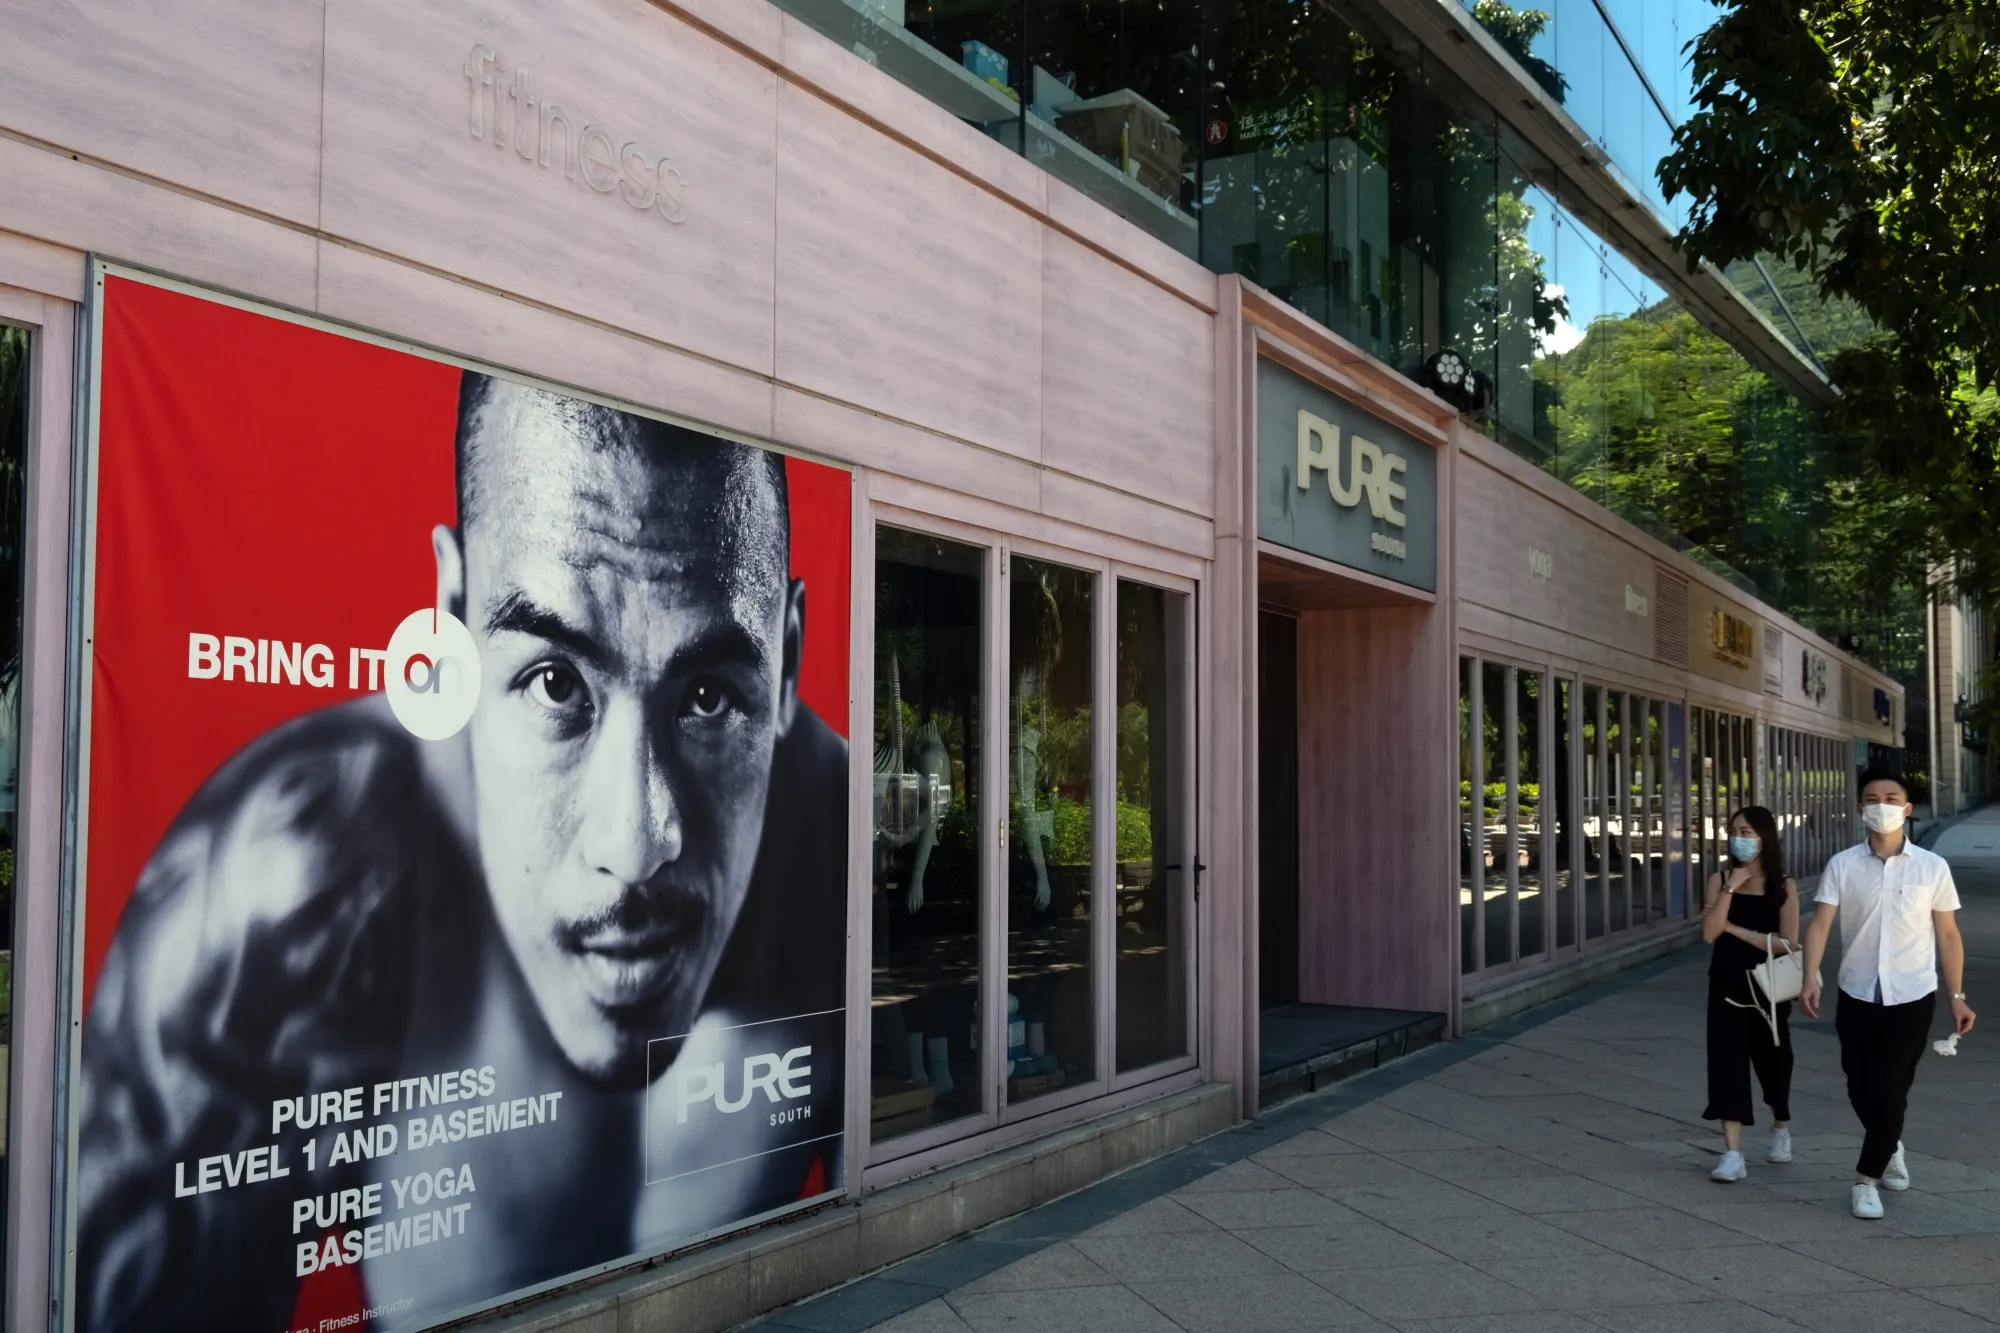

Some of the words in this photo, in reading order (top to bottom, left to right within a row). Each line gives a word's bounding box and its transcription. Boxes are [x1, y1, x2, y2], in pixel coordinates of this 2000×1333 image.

[464, 44, 689, 224] fitness
[1297, 408, 1407, 528] PURE
[188, 632, 335, 688] BRING
[349, 647, 388, 691] IT
[403, 653, 463, 695] on
[272, 1087, 364, 1135] PURE
[373, 1065, 497, 1116] FITNESS
[677, 1045, 812, 1125] PURE
[769, 1105, 812, 1127] SOUTH
[175, 1143, 290, 1199] LEVEL
[302, 1141, 317, 1172] 1
[328, 1124, 398, 1168] AND
[407, 1092, 563, 1152] BASEMENT
[293, 1182, 383, 1235] PURE
[391, 1163, 476, 1210] YOGA
[296, 1203, 472, 1278] BASEMENT
[319, 1311, 360, 1333] Fitness
[362, 1297, 414, 1321] Instructor
